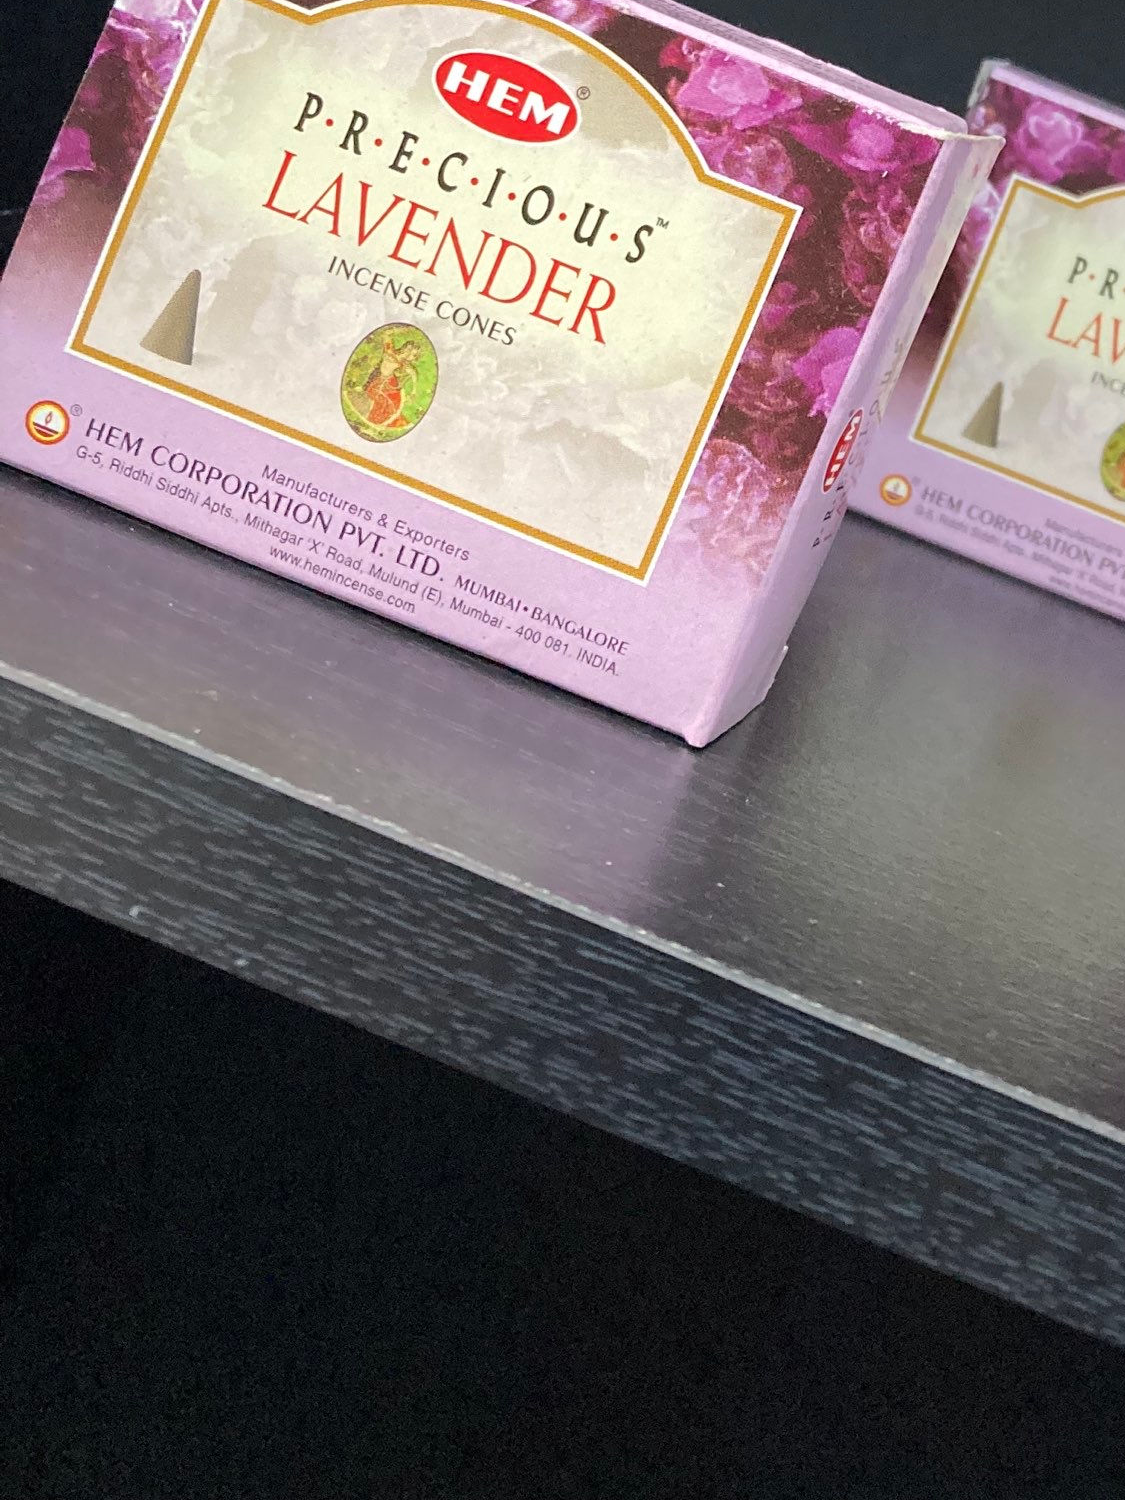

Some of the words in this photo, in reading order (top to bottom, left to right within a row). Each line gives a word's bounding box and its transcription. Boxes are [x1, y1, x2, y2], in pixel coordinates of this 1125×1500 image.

[443, 61, 569, 135] HEM
[262, 150, 617, 345] LAVENDER
[328, 256, 430, 311] INCENSE
[436, 300, 518, 346] CONES
[825, 414, 860, 487] HEM
[86, 418, 143, 457] HEM
[151, 445, 333, 534] CORPORATION
[339, 521, 384, 558] PVT.
[396, 545, 444, 581] LTD.
[262, 464, 373, 522] Manufacturers
[378, 513, 388, 528] &
[393, 520, 470, 562] Exporters
[921, 486, 963, 513] HEM
[966, 503, 1095, 567] CORPORATION
[109, 455, 154, 486] Riddhi
[156, 477, 199, 506] Siddhi
[244, 512, 304, 548] Mithagar
[325, 547, 364, 573] Road,
[369, 563, 419, 594] Mulund
[450, 596, 502, 629] Mumbai
[515, 625, 542, 645] 400
[576, 649, 620, 677] INDIA.
[269, 546, 416, 615] www.hemincense.com
